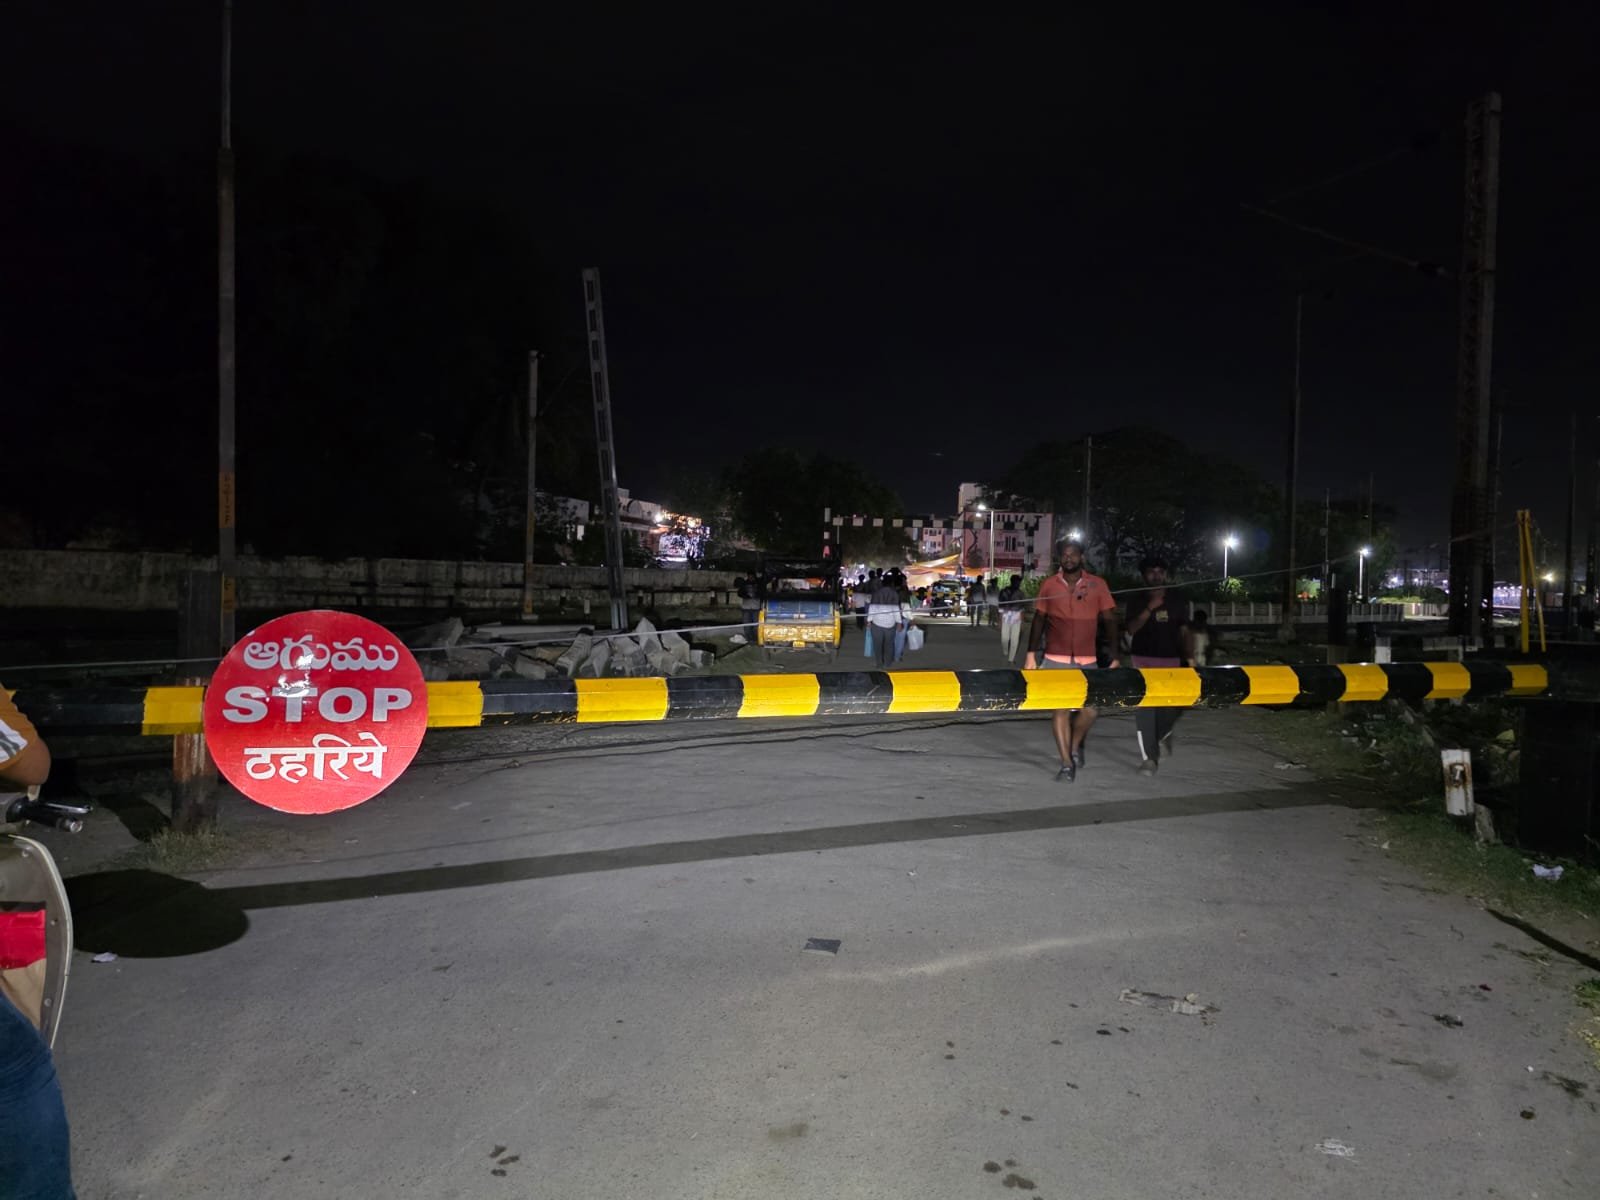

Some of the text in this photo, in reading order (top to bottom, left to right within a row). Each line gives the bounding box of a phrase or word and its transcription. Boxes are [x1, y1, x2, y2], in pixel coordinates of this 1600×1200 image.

[243, 634, 399, 671] ఆగుము
[222, 686, 413, 724] STOP
[244, 731, 388, 784] ठहरिये
